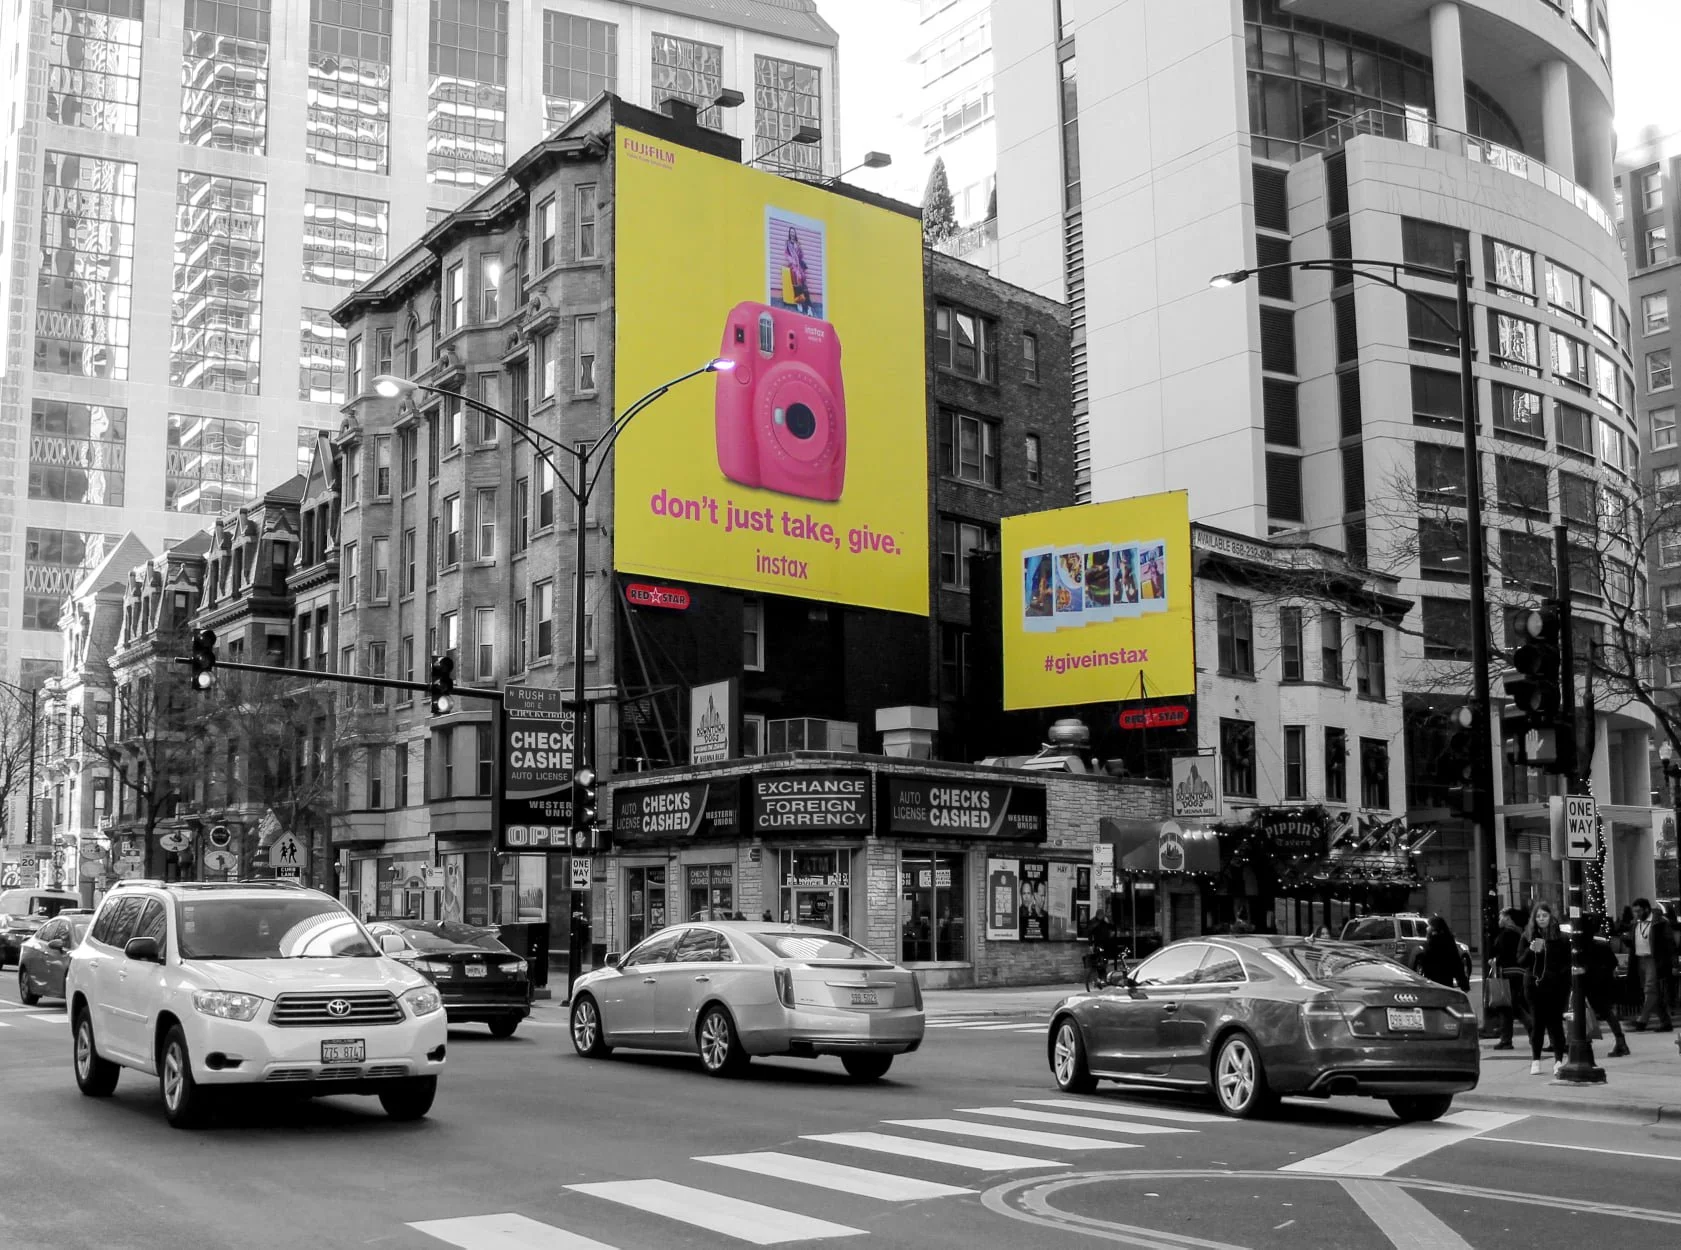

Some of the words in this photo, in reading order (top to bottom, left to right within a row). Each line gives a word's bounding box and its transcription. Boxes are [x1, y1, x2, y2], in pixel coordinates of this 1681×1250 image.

[624, 138, 675, 164] FUJIFILM
[651, 489, 718, 524] don't
[725, 500, 774, 533] just
[781, 511, 841, 550] take,
[849, 525, 901, 555] give.
[1198, 532, 1231, 552] AVAILABLE
[756, 549, 808, 580] instax
[631, 589, 650, 600] RED
[662, 593, 686, 605] STAR
[1045, 648, 1148, 674] #giveinstax
[518, 689, 544, 701] RUSH
[511, 731, 574, 750] CHECK
[511, 751, 573, 769] CASHE
[511, 772, 532, 780] AUTO
[536, 772, 568, 780] LICENSE
[758, 780, 865, 794] EXCHANGE
[643, 792, 690, 813] CHECKS
[900, 792, 921, 804] AUTO
[929, 788, 990, 809] CHECKS
[1176, 793, 1213, 801] DOWNTOWN
[529, 801, 572, 809] WESTER
[622, 803, 636, 815] AUTO
[766, 800, 855, 813] FOREIGN
[1183, 800, 1204, 808] DOGS
[1569, 802, 1593, 817] ONE
[545, 809, 572, 817] UNIO
[706, 810, 732, 819] WESTERN
[759, 813, 866, 826] CURRENCY
[893, 806, 926, 820] LICENSE
[930, 808, 990, 828] CASHED
[1008, 814, 1039, 823] WESTERN
[616, 817, 640, 830] LICENSE
[643, 812, 690, 832] CASHED
[713, 818, 732, 826] UNION
[1017, 822, 1038, 830] UNION
[1569, 819, 1593, 834] WAY
[508, 825, 573, 846] OPE
[573, 860, 589, 868] ONE
[573, 869, 589, 877] WAY
[344, 1046, 364, 1058] 8747
